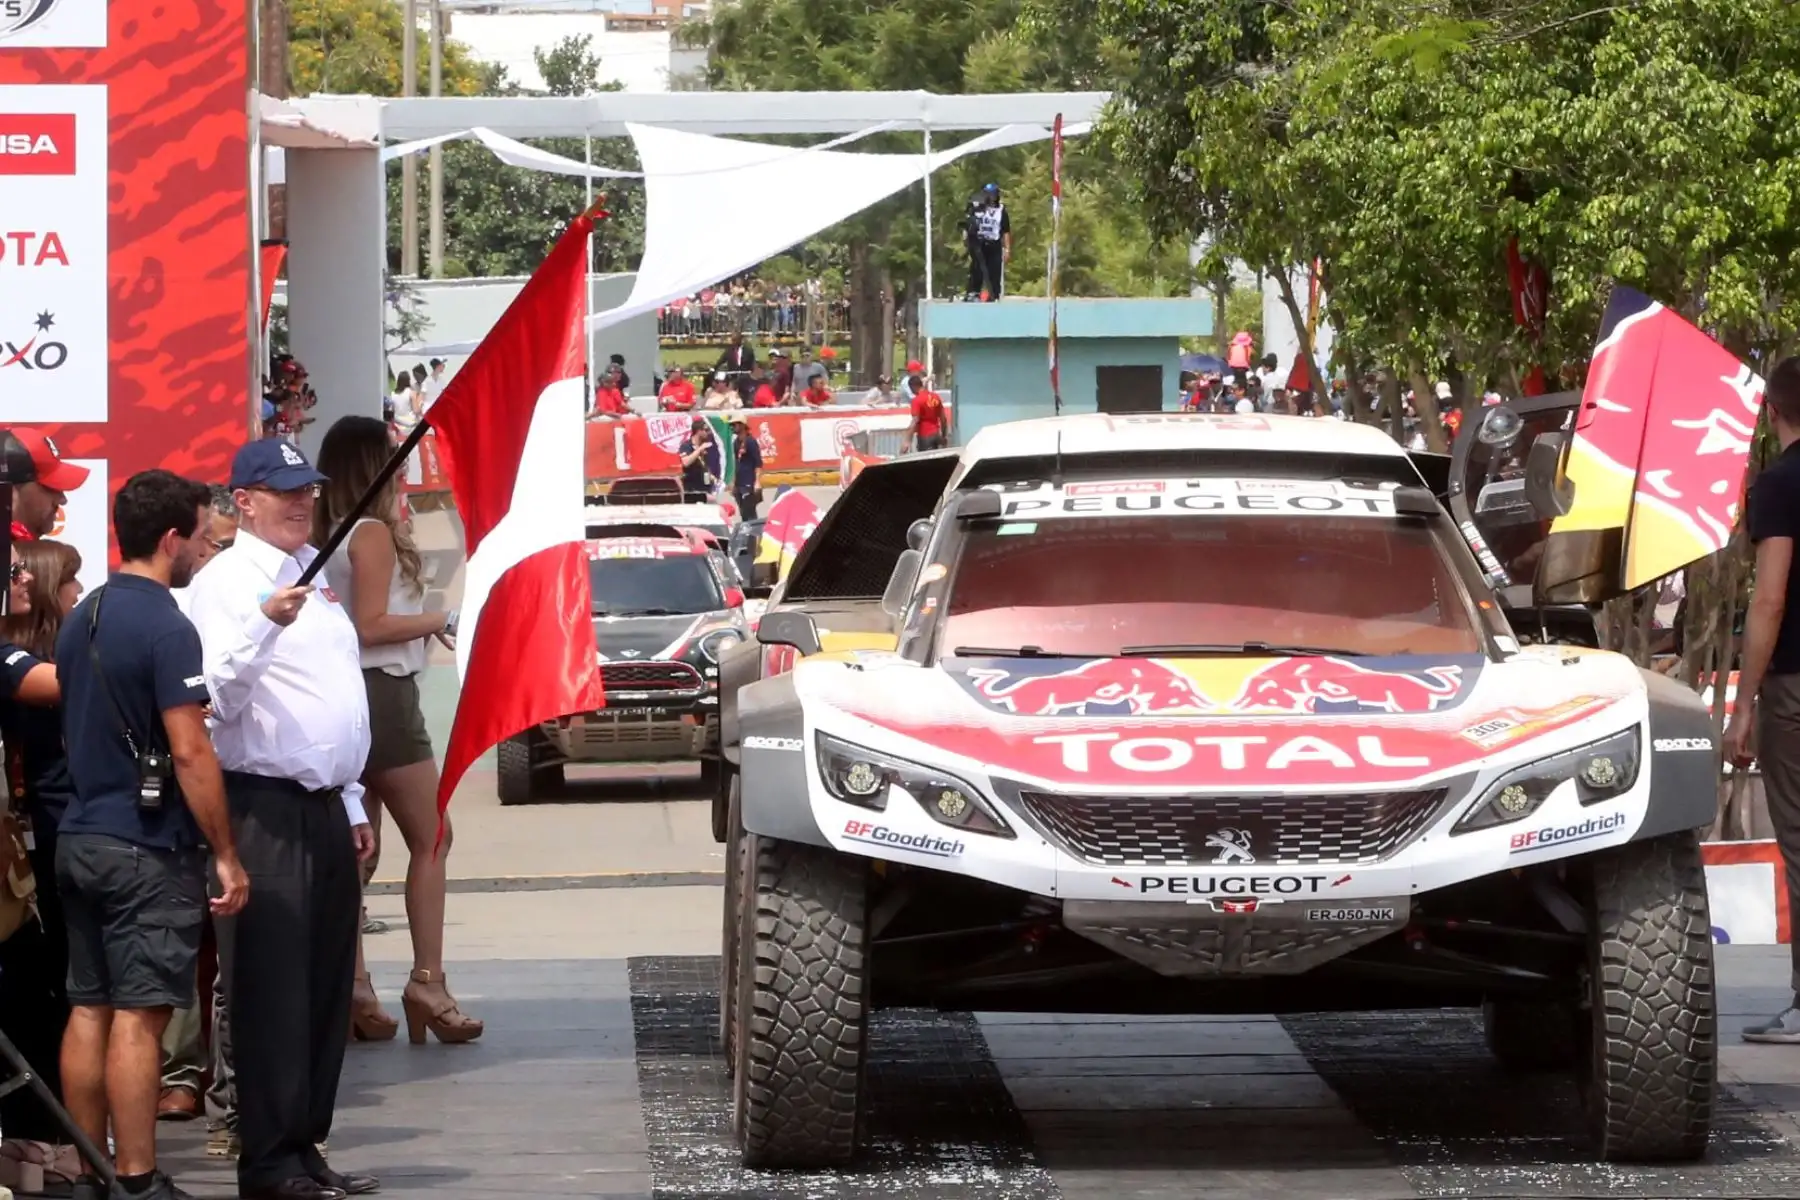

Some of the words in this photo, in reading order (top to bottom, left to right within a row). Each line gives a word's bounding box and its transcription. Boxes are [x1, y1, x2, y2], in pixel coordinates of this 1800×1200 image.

[0, 232, 70, 266] TA
[1005, 494, 1390, 515] PEUGEOT
[1467, 718, 1511, 738] 306
[744, 736, 804, 750] sparco
[1033, 733, 1430, 772] TOTAL
[1653, 738, 1712, 751] sparco
[844, 820, 964, 853] BFGoodrich
[1510, 812, 1625, 848] BFGoodrich
[1140, 876, 1327, 893] PEUGEOT
[1309, 909, 1392, 920] ER-050-NK
